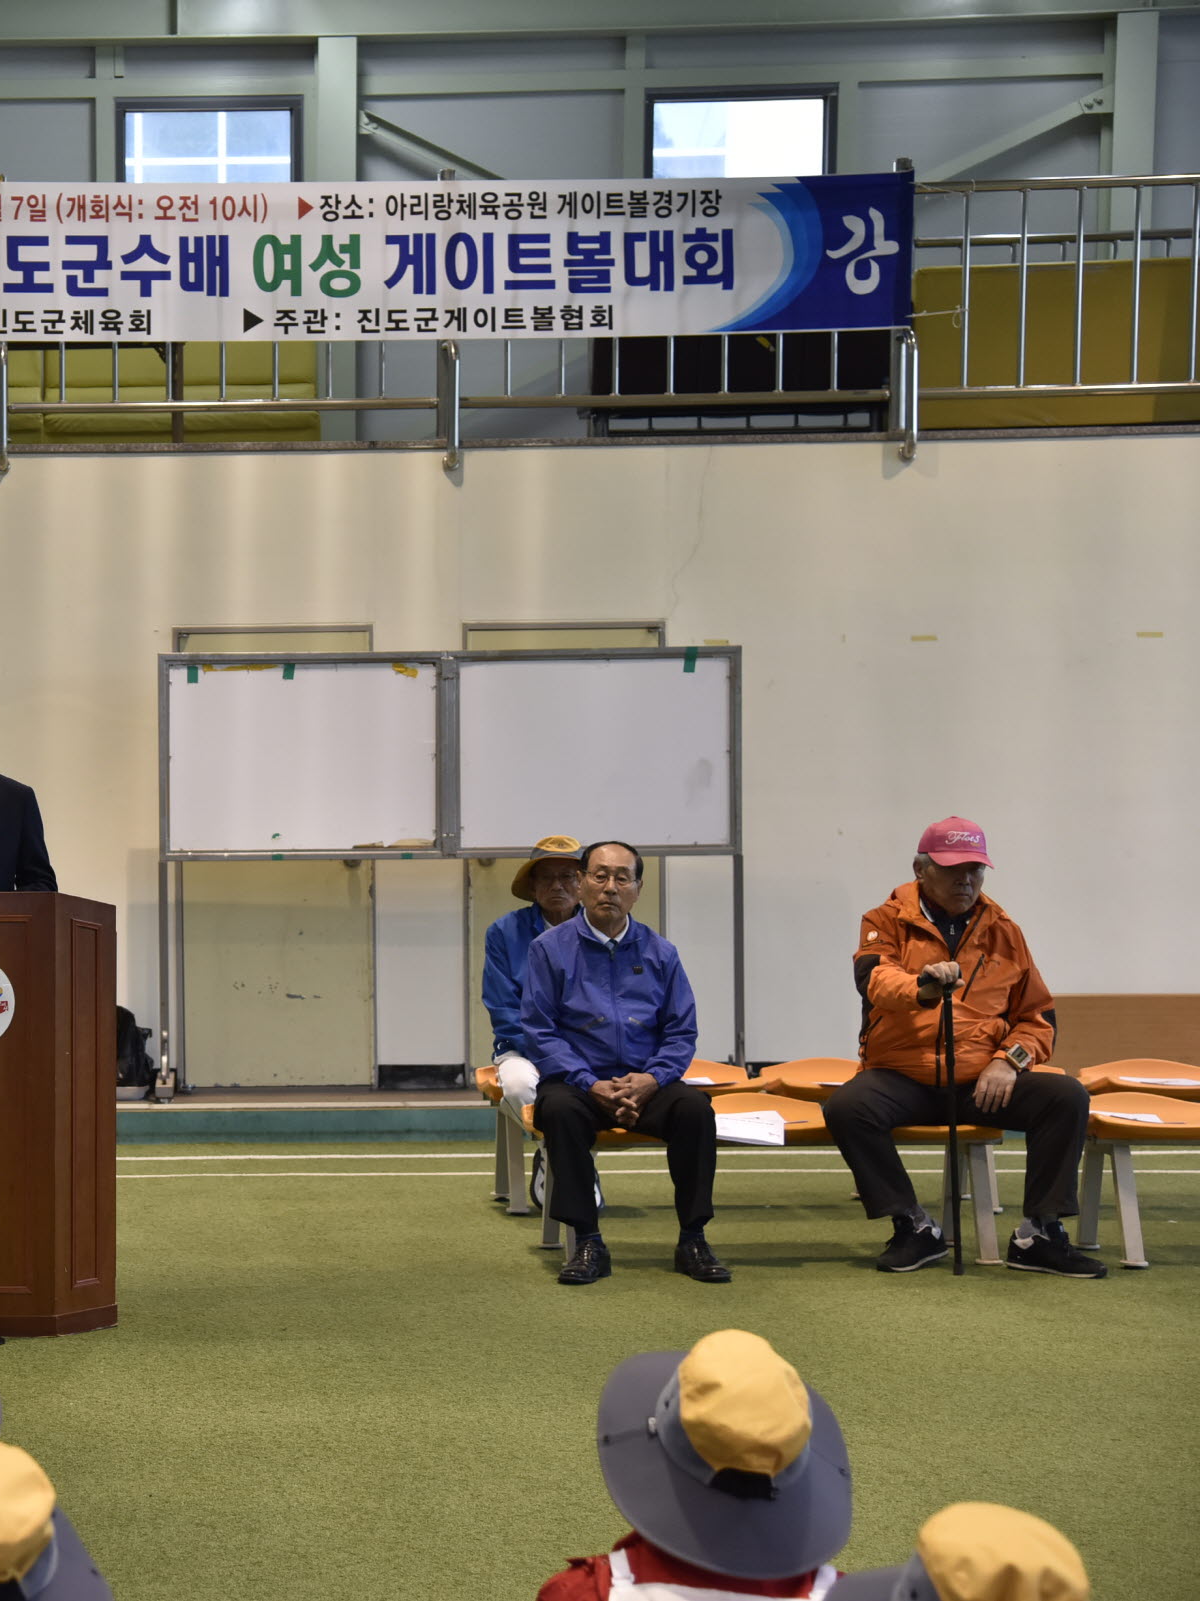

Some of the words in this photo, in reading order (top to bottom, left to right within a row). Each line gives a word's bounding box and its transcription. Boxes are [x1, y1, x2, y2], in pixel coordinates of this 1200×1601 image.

[10, 194, 47, 223] 7일
[55, 193, 144, 224] (개회식:
[154, 194, 199, 223] 오전
[209, 193, 268, 224] 10시)
[319, 193, 374, 223] 장소:
[385, 190, 548, 221] 아리랑체육공원
[556, 188, 725, 220] 게이트볼경기장
[253, 233, 362, 299] 여성
[383, 226, 735, 296] 게이트볼대회
[826, 207, 900, 295] 강
[273, 308, 341, 335] 주관:
[356, 304, 614, 334] 진도군게이트볼협회
